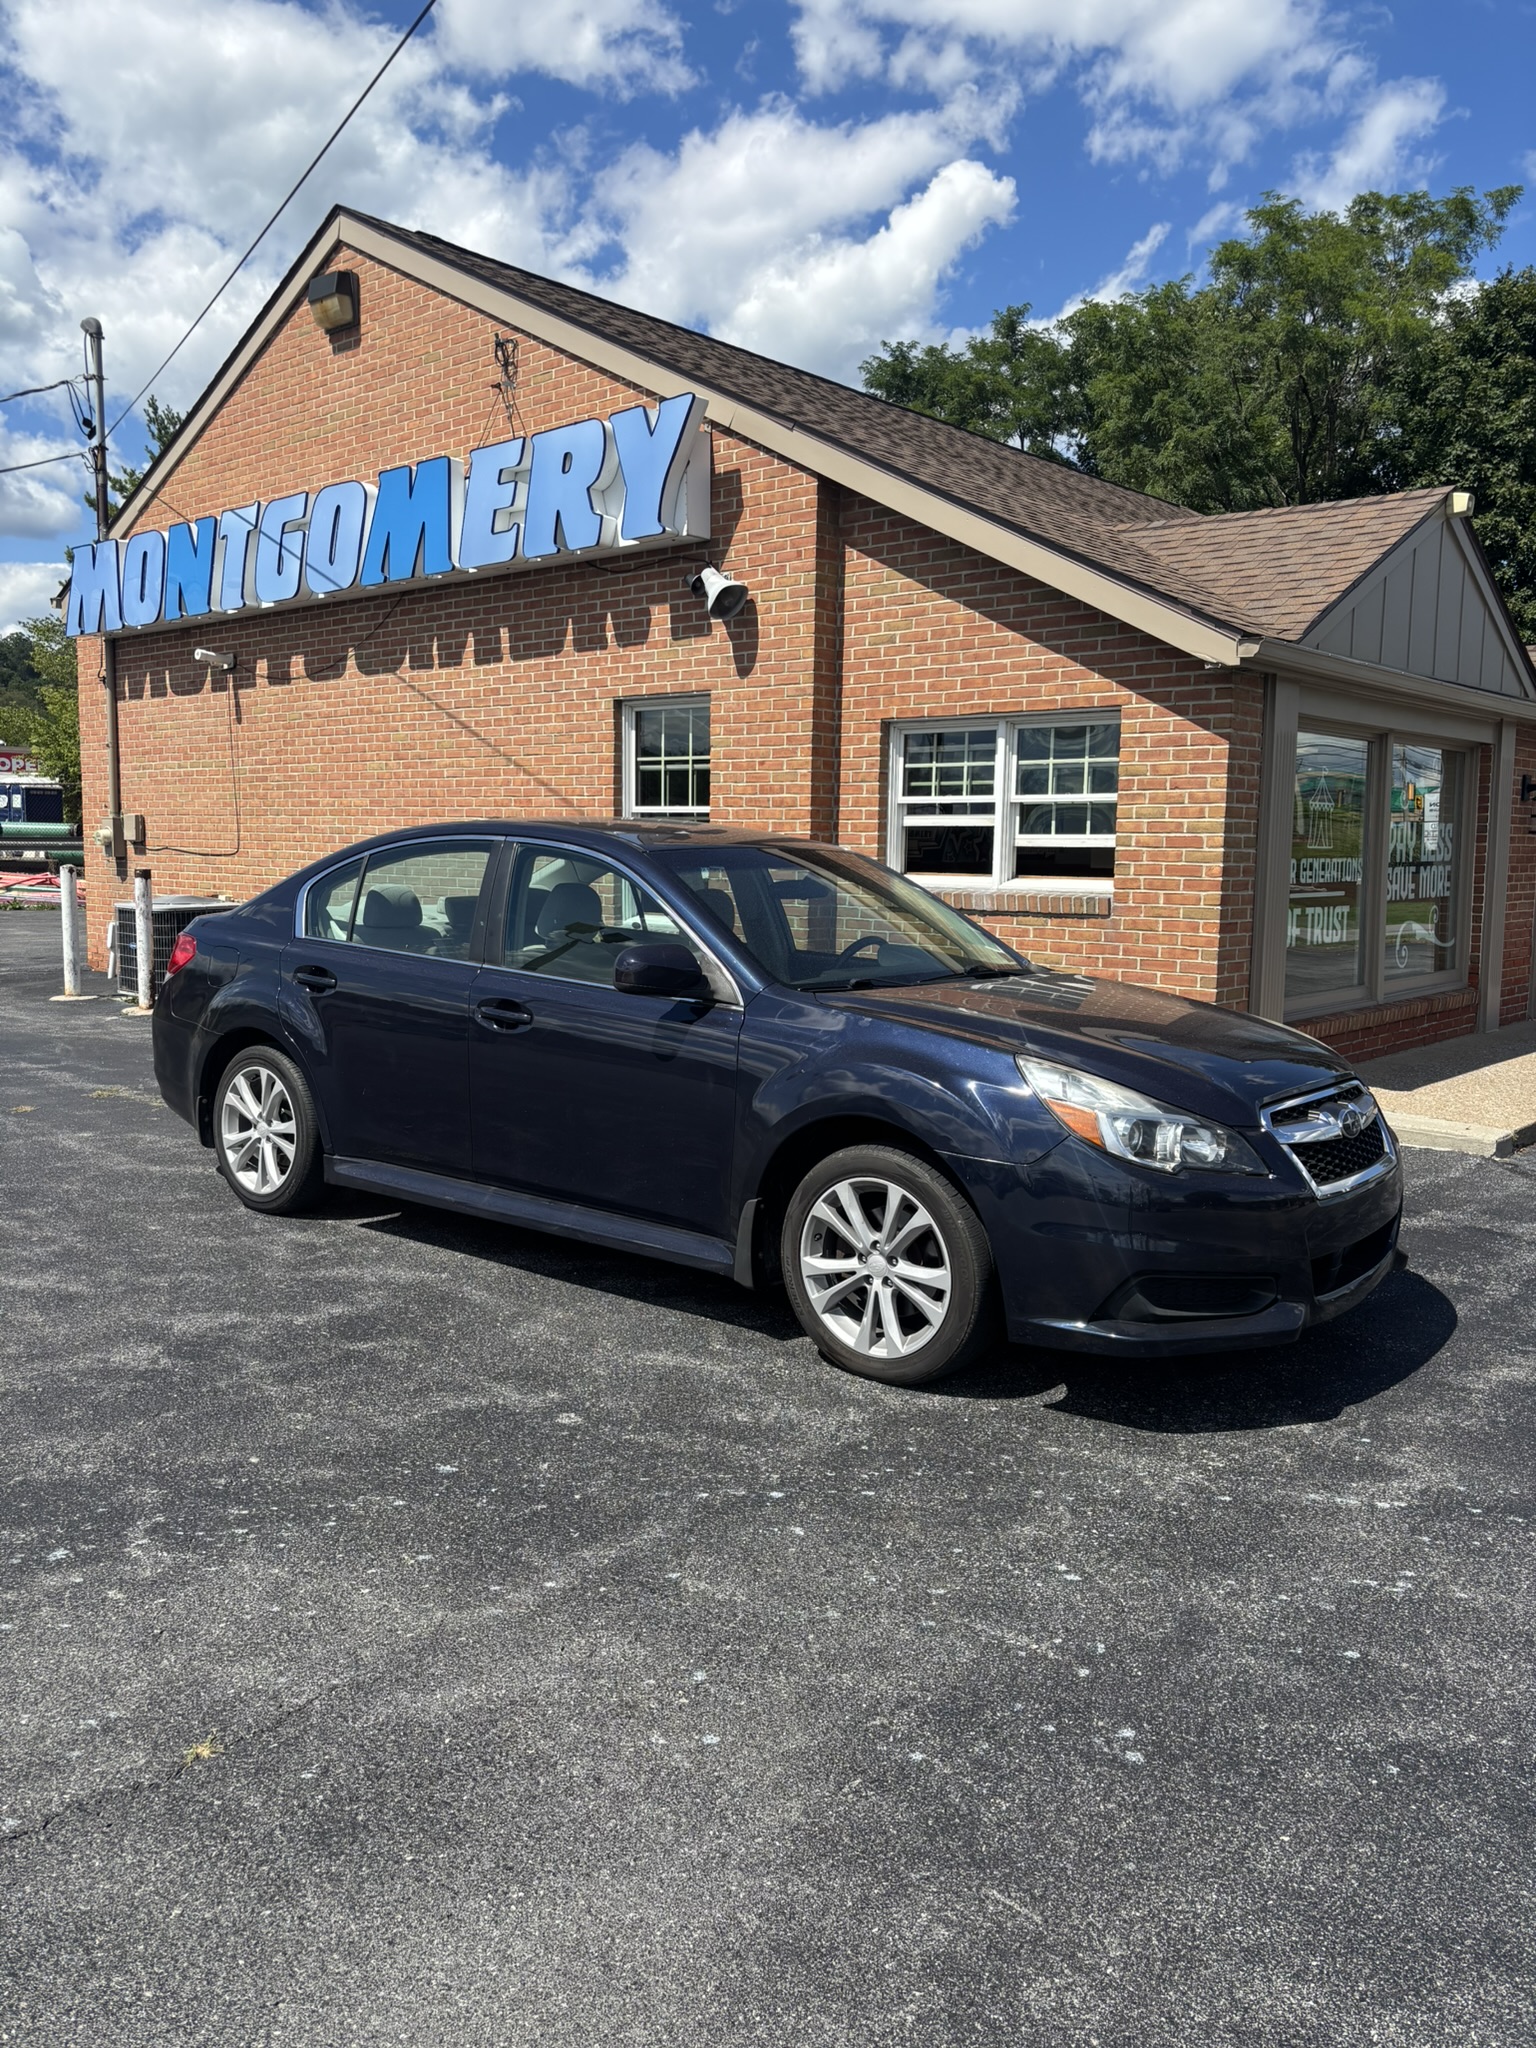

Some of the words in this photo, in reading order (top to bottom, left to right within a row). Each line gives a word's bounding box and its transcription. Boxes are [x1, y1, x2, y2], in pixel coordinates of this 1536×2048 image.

[65, 392, 698, 637] MONTGOMERY
[1388, 821, 1417, 862] PAY
[1420, 823, 1453, 862] LESS
[1299, 857, 1363, 884] GENERATIONS
[1386, 866, 1416, 901] SAVE
[1418, 865, 1452, 899] MORE
[1305, 905, 1350, 946] TRUST
